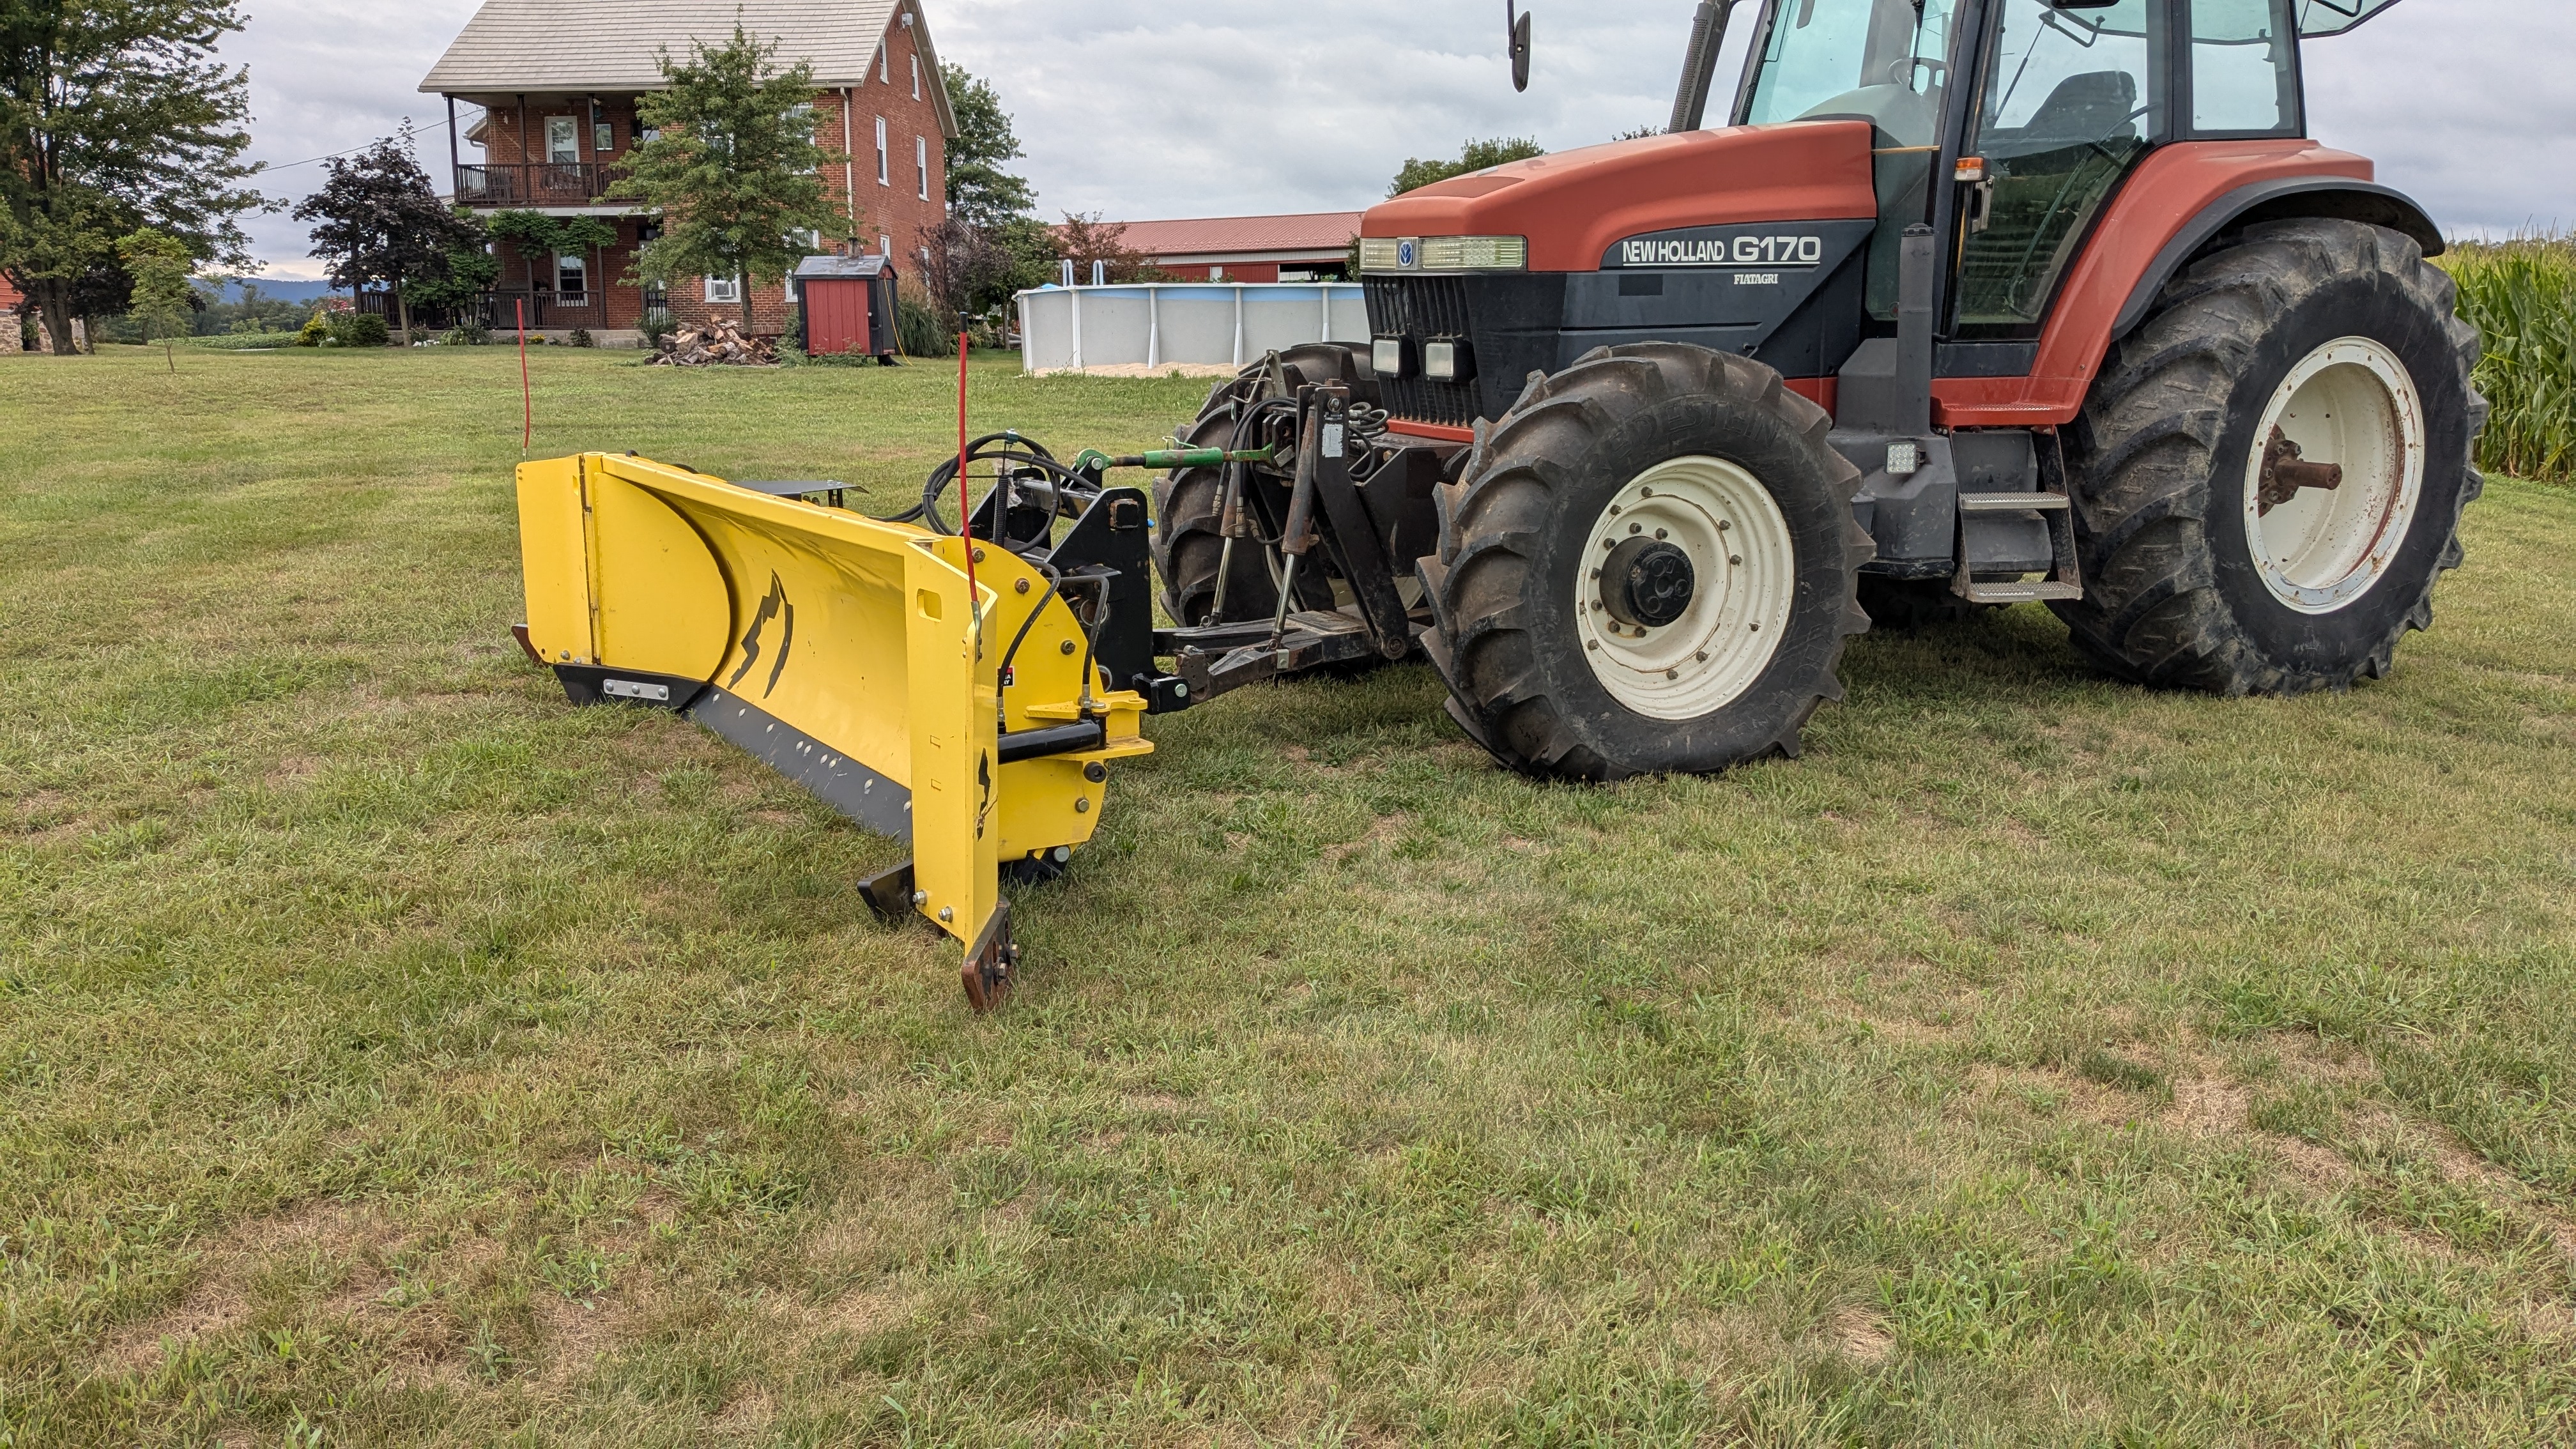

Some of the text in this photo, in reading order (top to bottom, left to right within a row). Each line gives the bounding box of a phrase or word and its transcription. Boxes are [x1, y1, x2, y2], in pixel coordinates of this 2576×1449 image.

[1623, 236, 1821, 262] NEW HOLLAND G170
[1733, 273, 1778, 285] FIATAGRI
